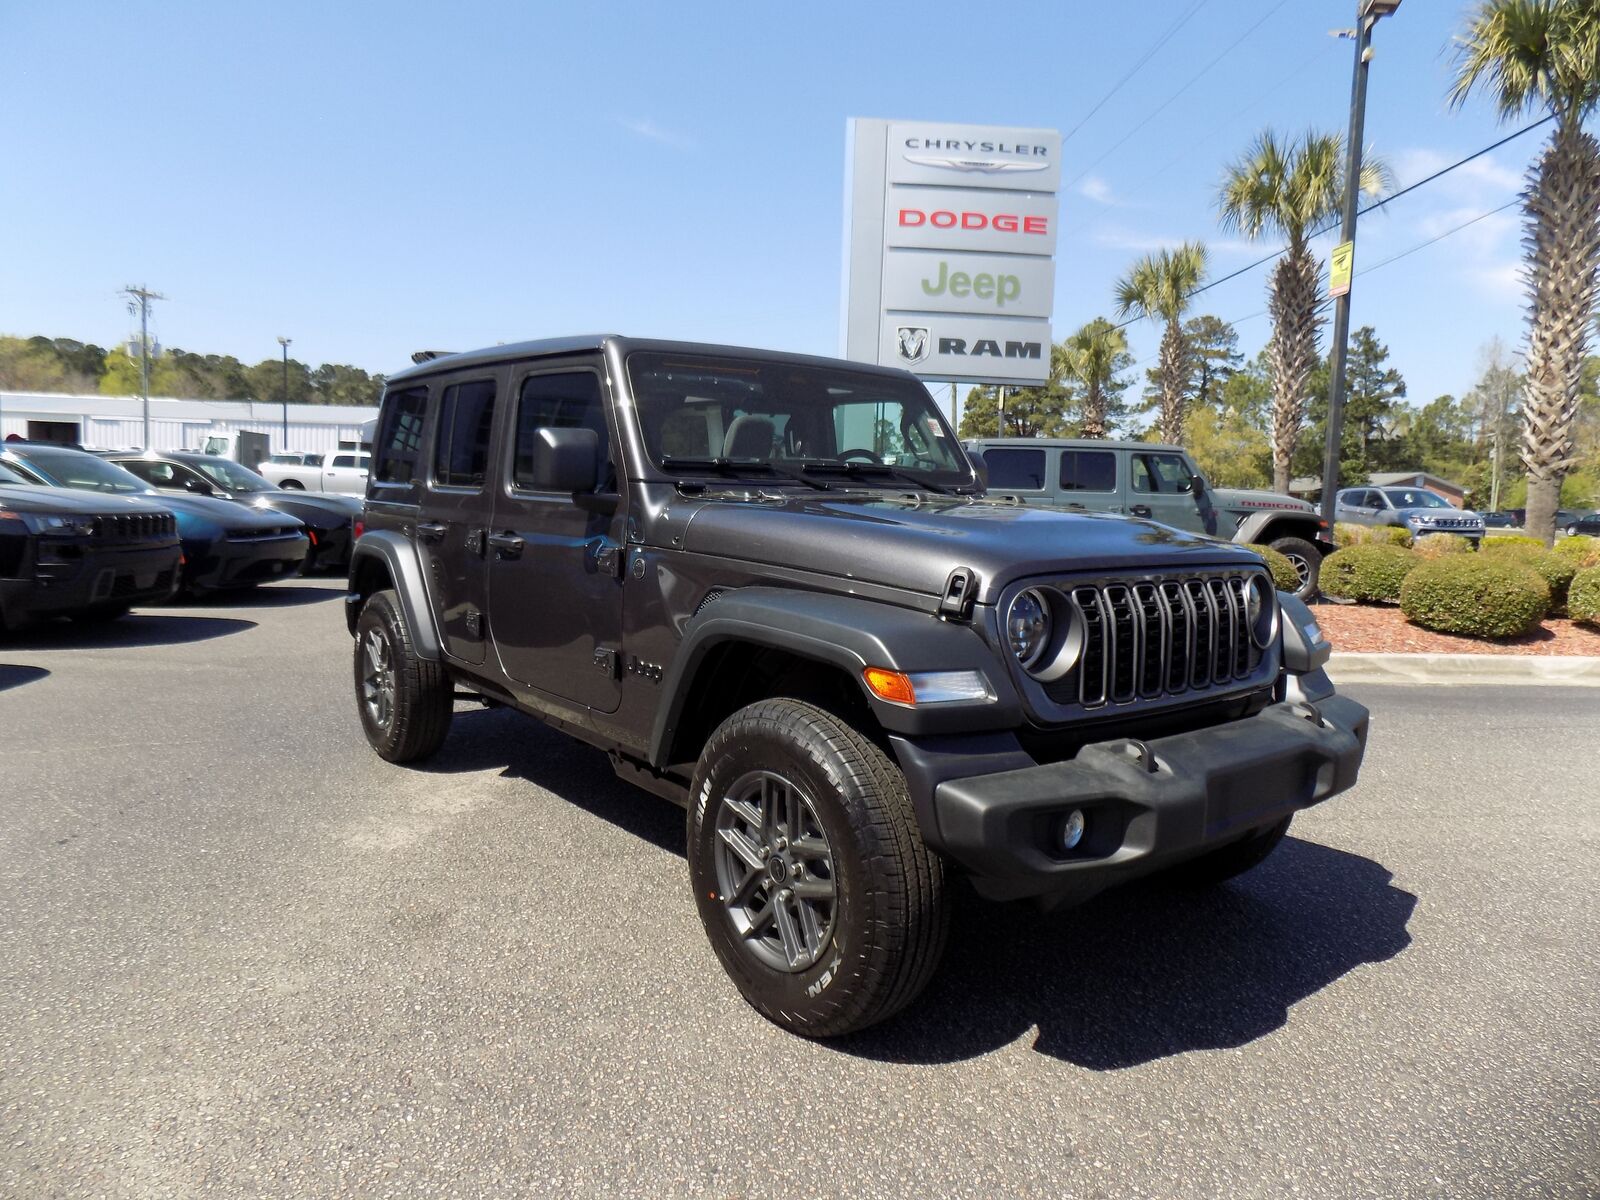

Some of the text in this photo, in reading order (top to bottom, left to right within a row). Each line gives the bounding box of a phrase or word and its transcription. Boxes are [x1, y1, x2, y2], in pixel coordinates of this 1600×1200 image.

[905, 138, 1048, 157] CHRYSLER
[898, 209, 1048, 235] DODGE
[921, 261, 1022, 306] Jeep
[938, 337, 1042, 359] RAM
[1241, 501, 1304, 511] RUBICON
